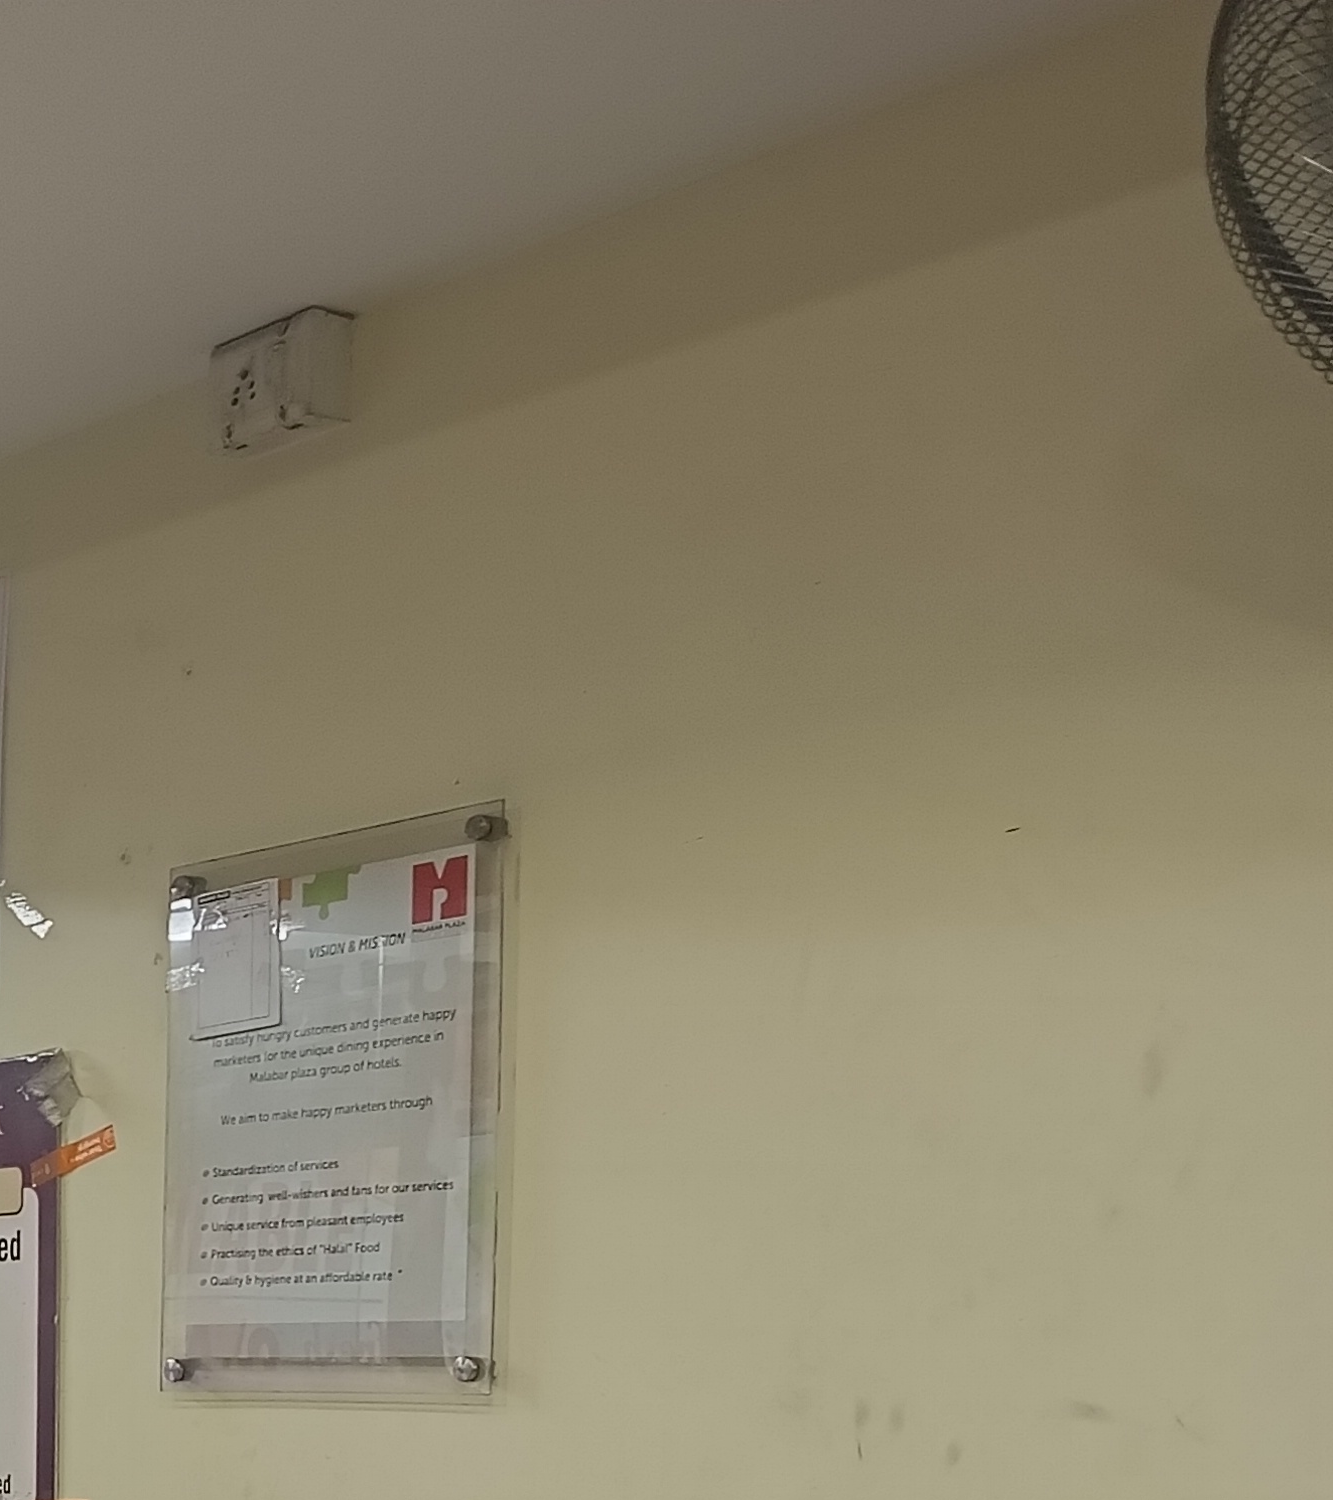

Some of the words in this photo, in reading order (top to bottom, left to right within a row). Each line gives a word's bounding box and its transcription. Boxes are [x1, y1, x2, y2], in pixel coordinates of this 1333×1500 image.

[308, 941, 346, 960] VISION
[257, 1030, 292, 1045] hungry
[293, 1022, 348, 1038] customers
[349, 1019, 370, 1031] and
[372, 1013, 420, 1030] generate
[422, 1007, 457, 1022] happy
[213, 1052, 262, 1068] marketers
[280, 1048, 297, 1060] the
[299, 1045, 334, 1060] unique
[336, 1040, 370, 1055] dining
[372, 1033, 431, 1050] experience
[433, 1030, 445, 1041] in
[249, 1069, 289, 1084] Malabar
[290, 1066, 318, 1081] plaza
[319, 1063, 352, 1079] group
[353, 1060, 365, 1072] of
[220, 1114, 236, 1126] We
[238, 1112, 257, 1124] aim
[258, 1111, 270, 1123] to
[272, 1108, 299, 1122] make
[300, 1106, 333, 1120] happy
[334, 1100, 387, 1116] marketers
[389, 1095, 433, 1111] through
[212, 1162, 285, 1178] Standardization
[287, 1160, 298, 1172] of
[300, 1159, 340, 1172] services
[212, 1191, 264, 1206] Generating
[331, 1185, 350, 1198] and
[374, 1183, 389, 1195] for
[391, 1183, 410, 1194] our
[412, 1179, 454, 1193] services
[211, 1220, 245, 1234] Unique
[246, 1218, 280, 1231] service
[281, 1217, 305, 1229] from
[306, 1214, 348, 1230] pleasant
[350, 1212, 405, 1227] employees
[258, 1246, 274, 1258] the
[276, 1244, 305, 1257] ethics
[306, 1243, 317, 1255] of
[354, 1241, 381, 1254] Food
[210, 1275, 244, 1288] Quality
[254, 1273, 292, 1287] hygiene
[293, 1273, 304, 1284] at
[305, 1274, 318, 1284] an
[372, 1270, 393, 1282] rate
